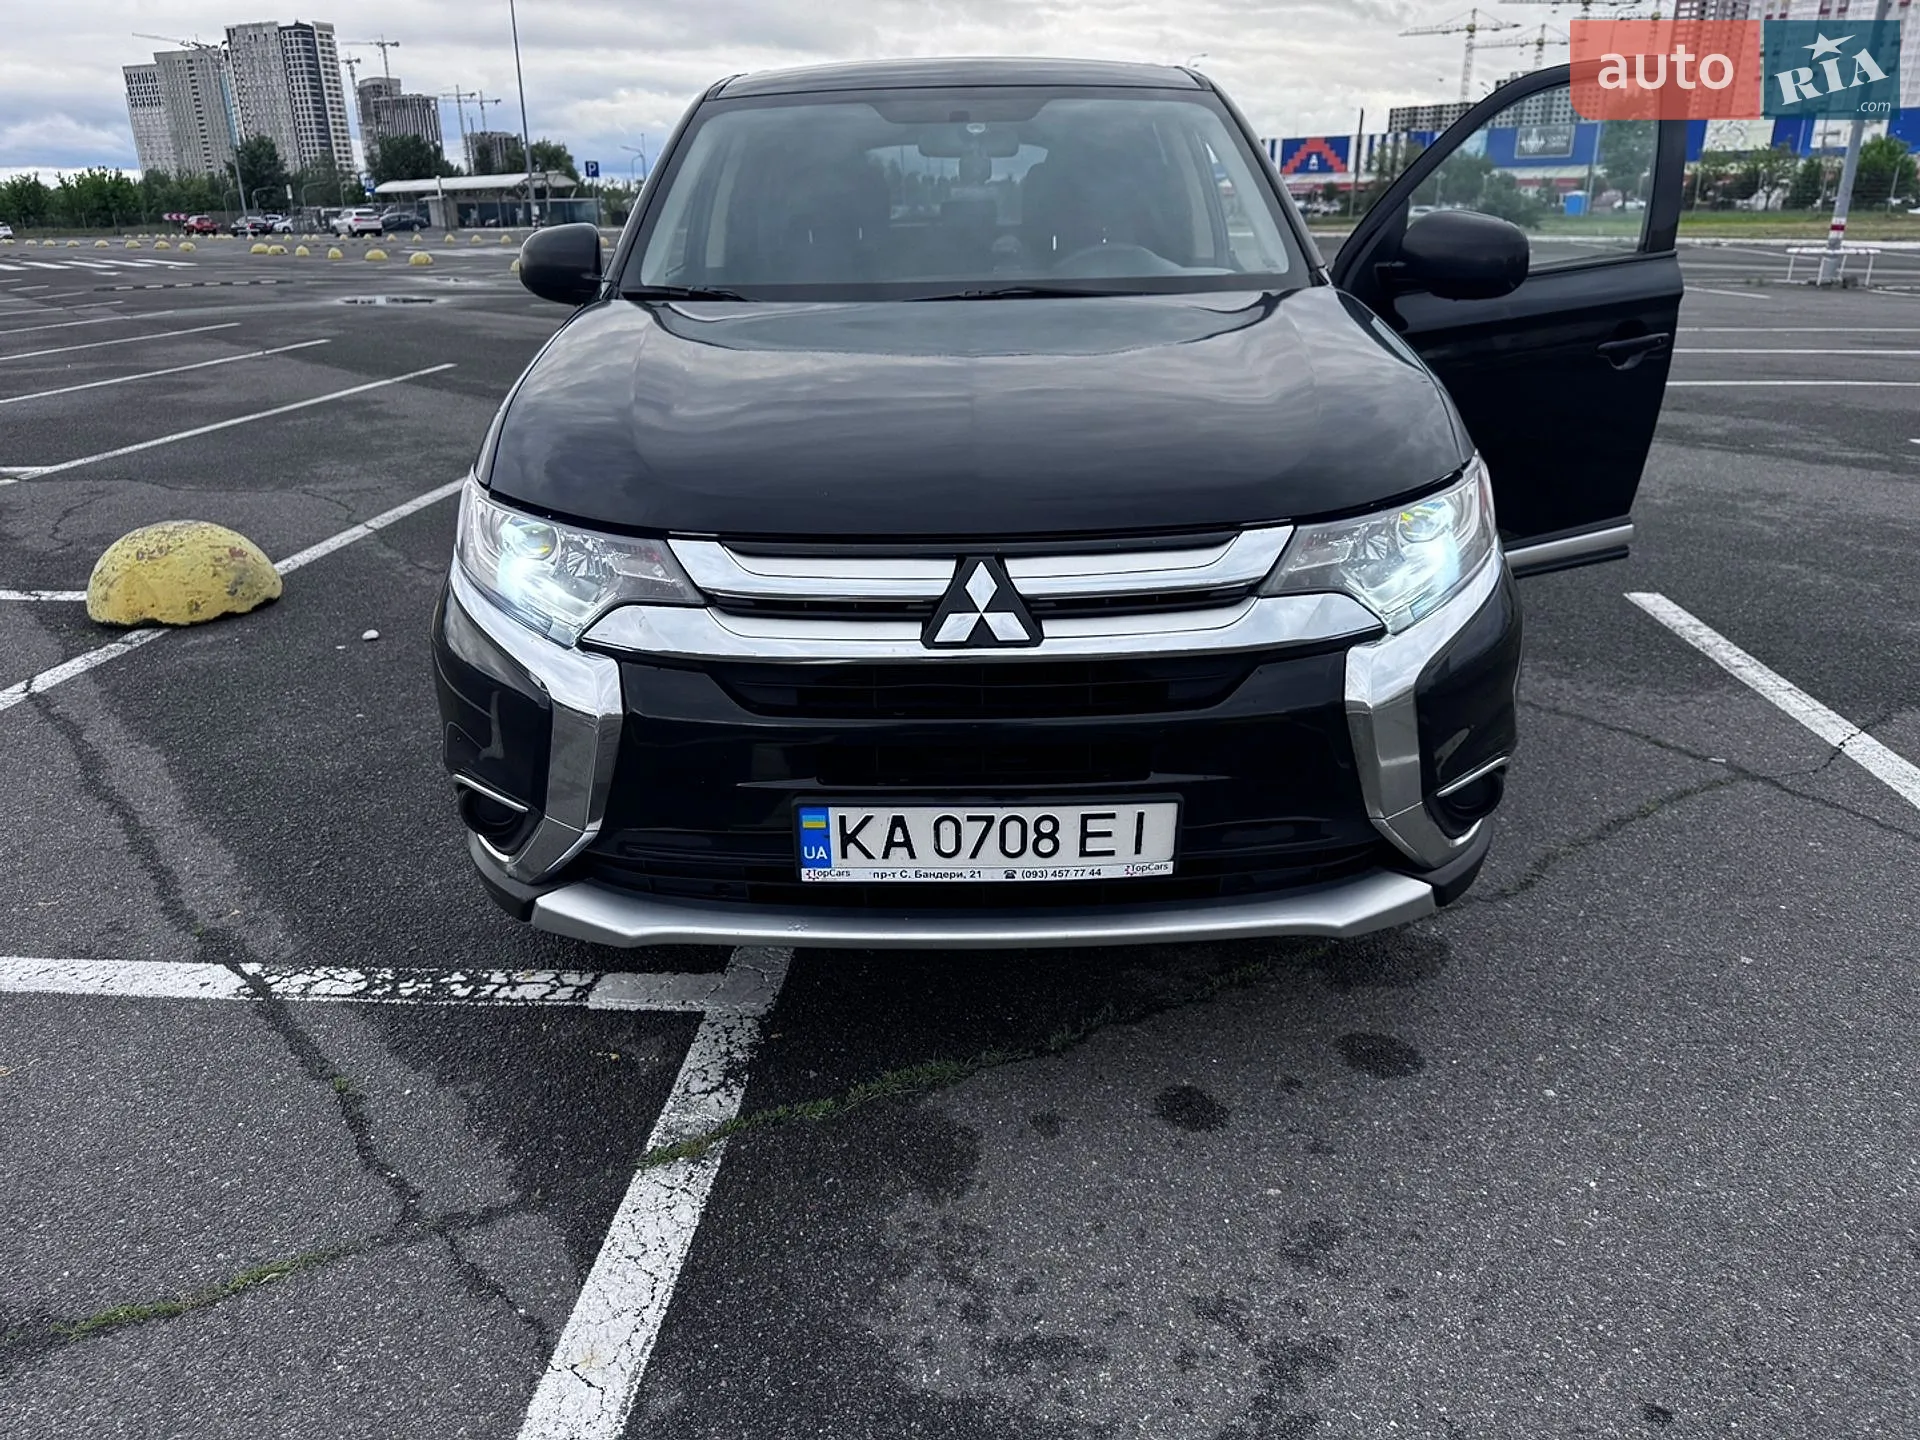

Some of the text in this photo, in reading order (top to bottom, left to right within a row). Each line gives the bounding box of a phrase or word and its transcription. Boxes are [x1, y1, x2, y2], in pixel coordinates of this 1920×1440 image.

[587, 162, 597, 176] P
[838, 814, 917, 860] KA
[933, 814, 1060, 860] 0708
[803, 846, 828, 860] UA
[969, 869, 982, 878] 21
[1021, 868, 1102, 879] (093) 457 77 44
